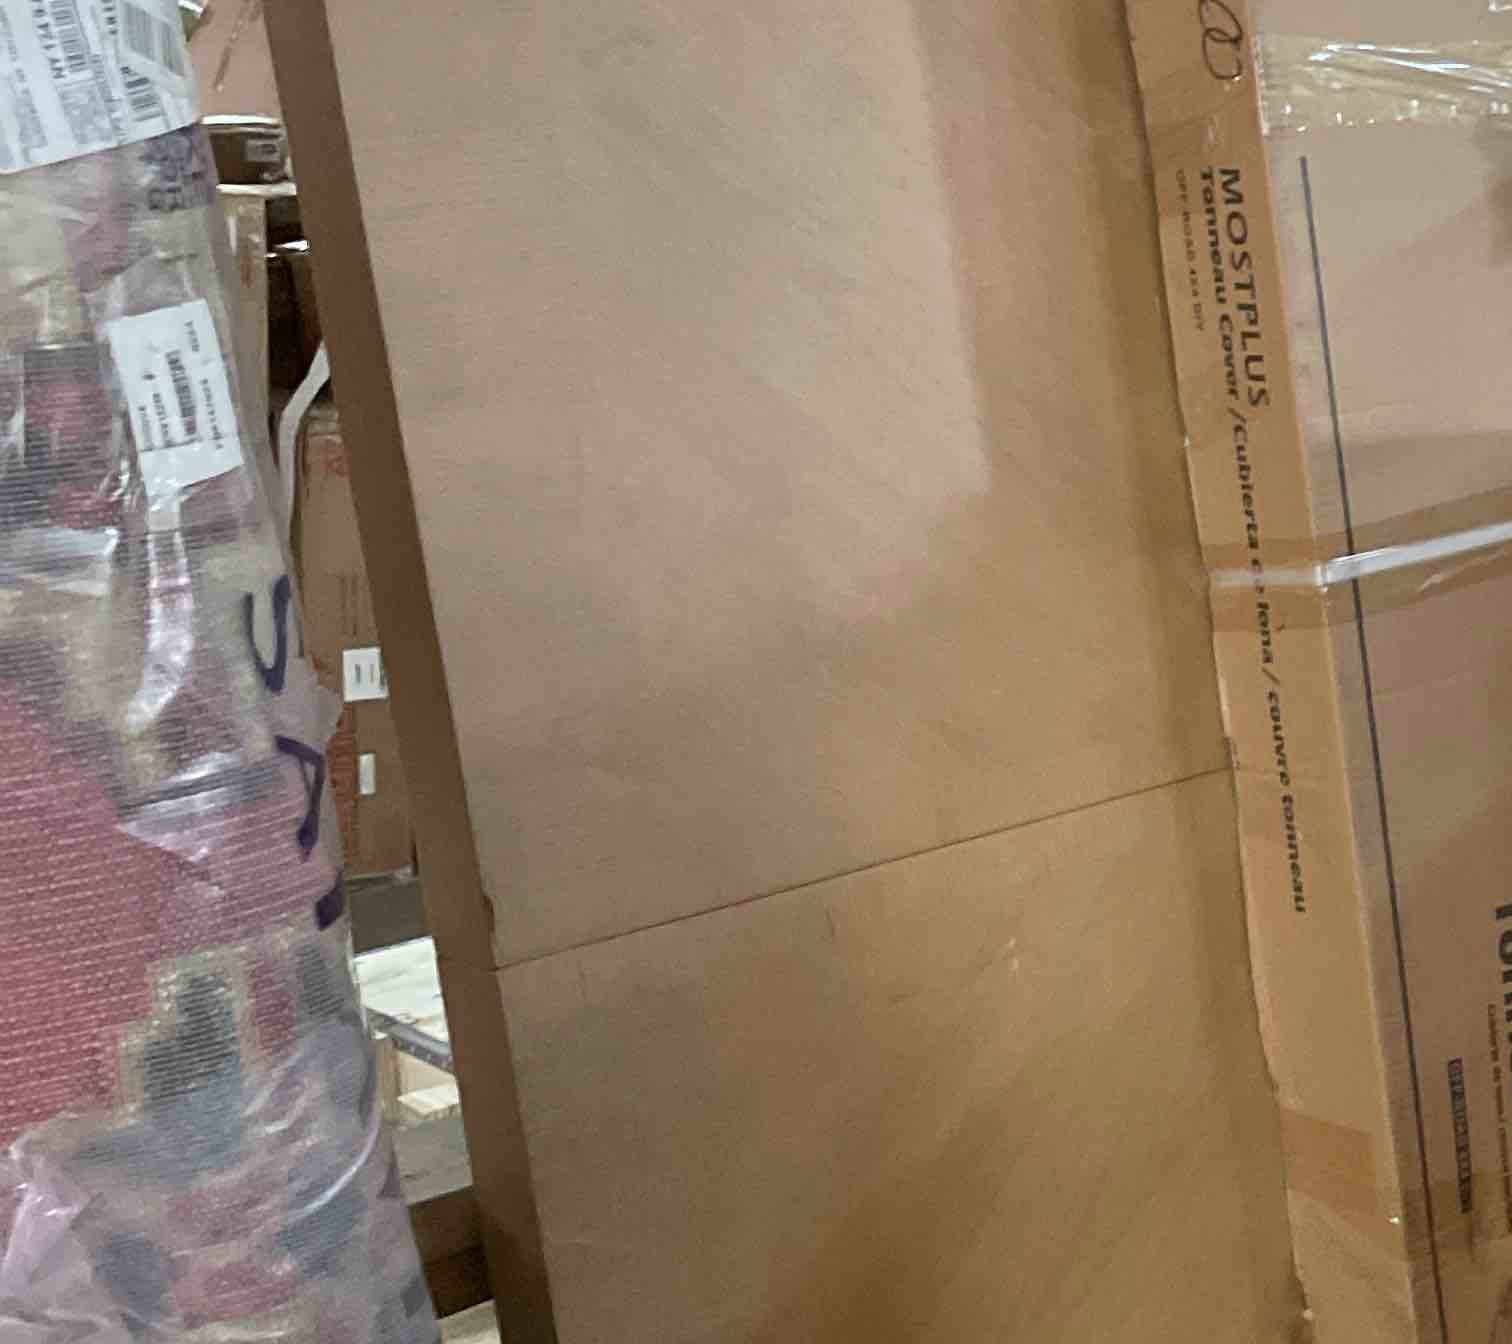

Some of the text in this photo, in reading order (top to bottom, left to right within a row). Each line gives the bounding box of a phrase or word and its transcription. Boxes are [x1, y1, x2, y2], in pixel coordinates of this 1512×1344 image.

[1219, 167, 1270, 408] MOSTPLUS
[1201, 166, 1227, 305] Tonneau
[1217, 313, 1240, 401] Cover
[1267, 690, 1291, 787] couvre
[1281, 793, 1307, 913] tonneau
